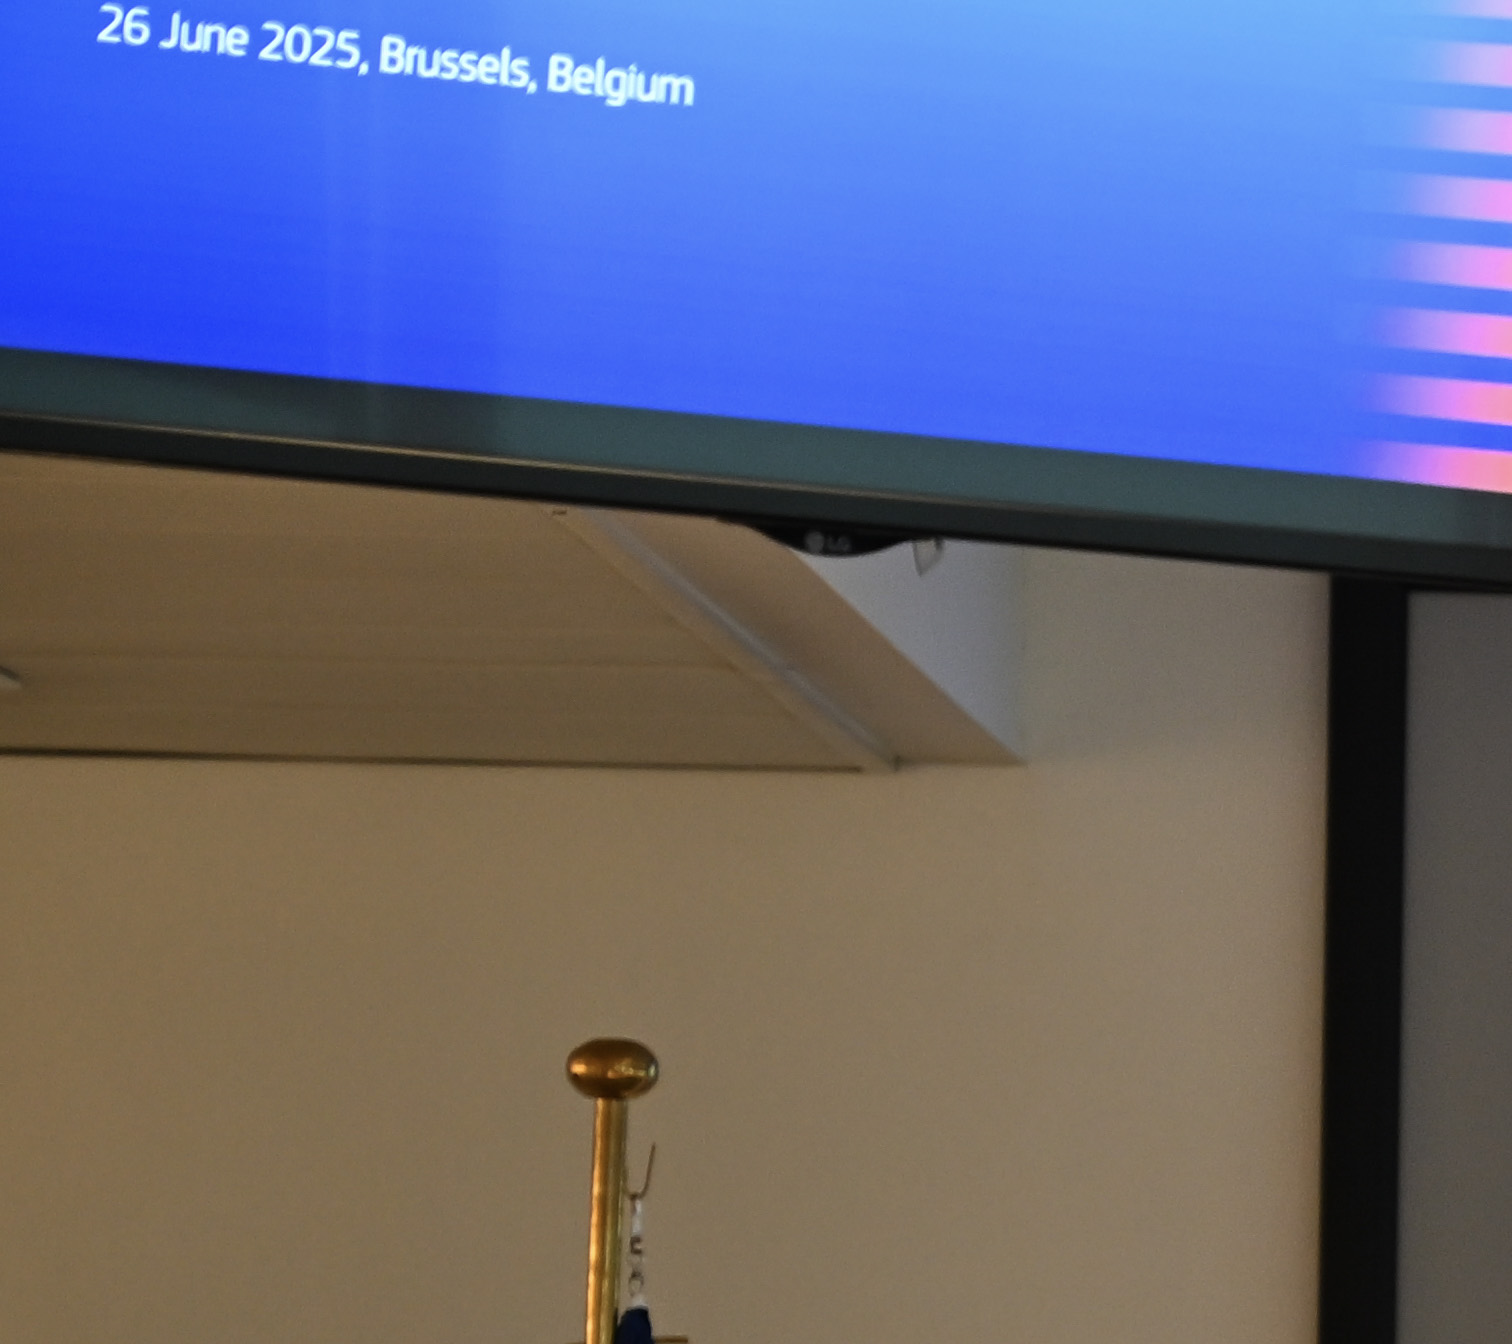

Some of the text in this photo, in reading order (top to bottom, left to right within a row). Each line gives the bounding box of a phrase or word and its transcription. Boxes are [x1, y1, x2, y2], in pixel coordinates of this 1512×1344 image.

[97, 3, 695, 107] 26 June 2025, Brussels, Belgium
